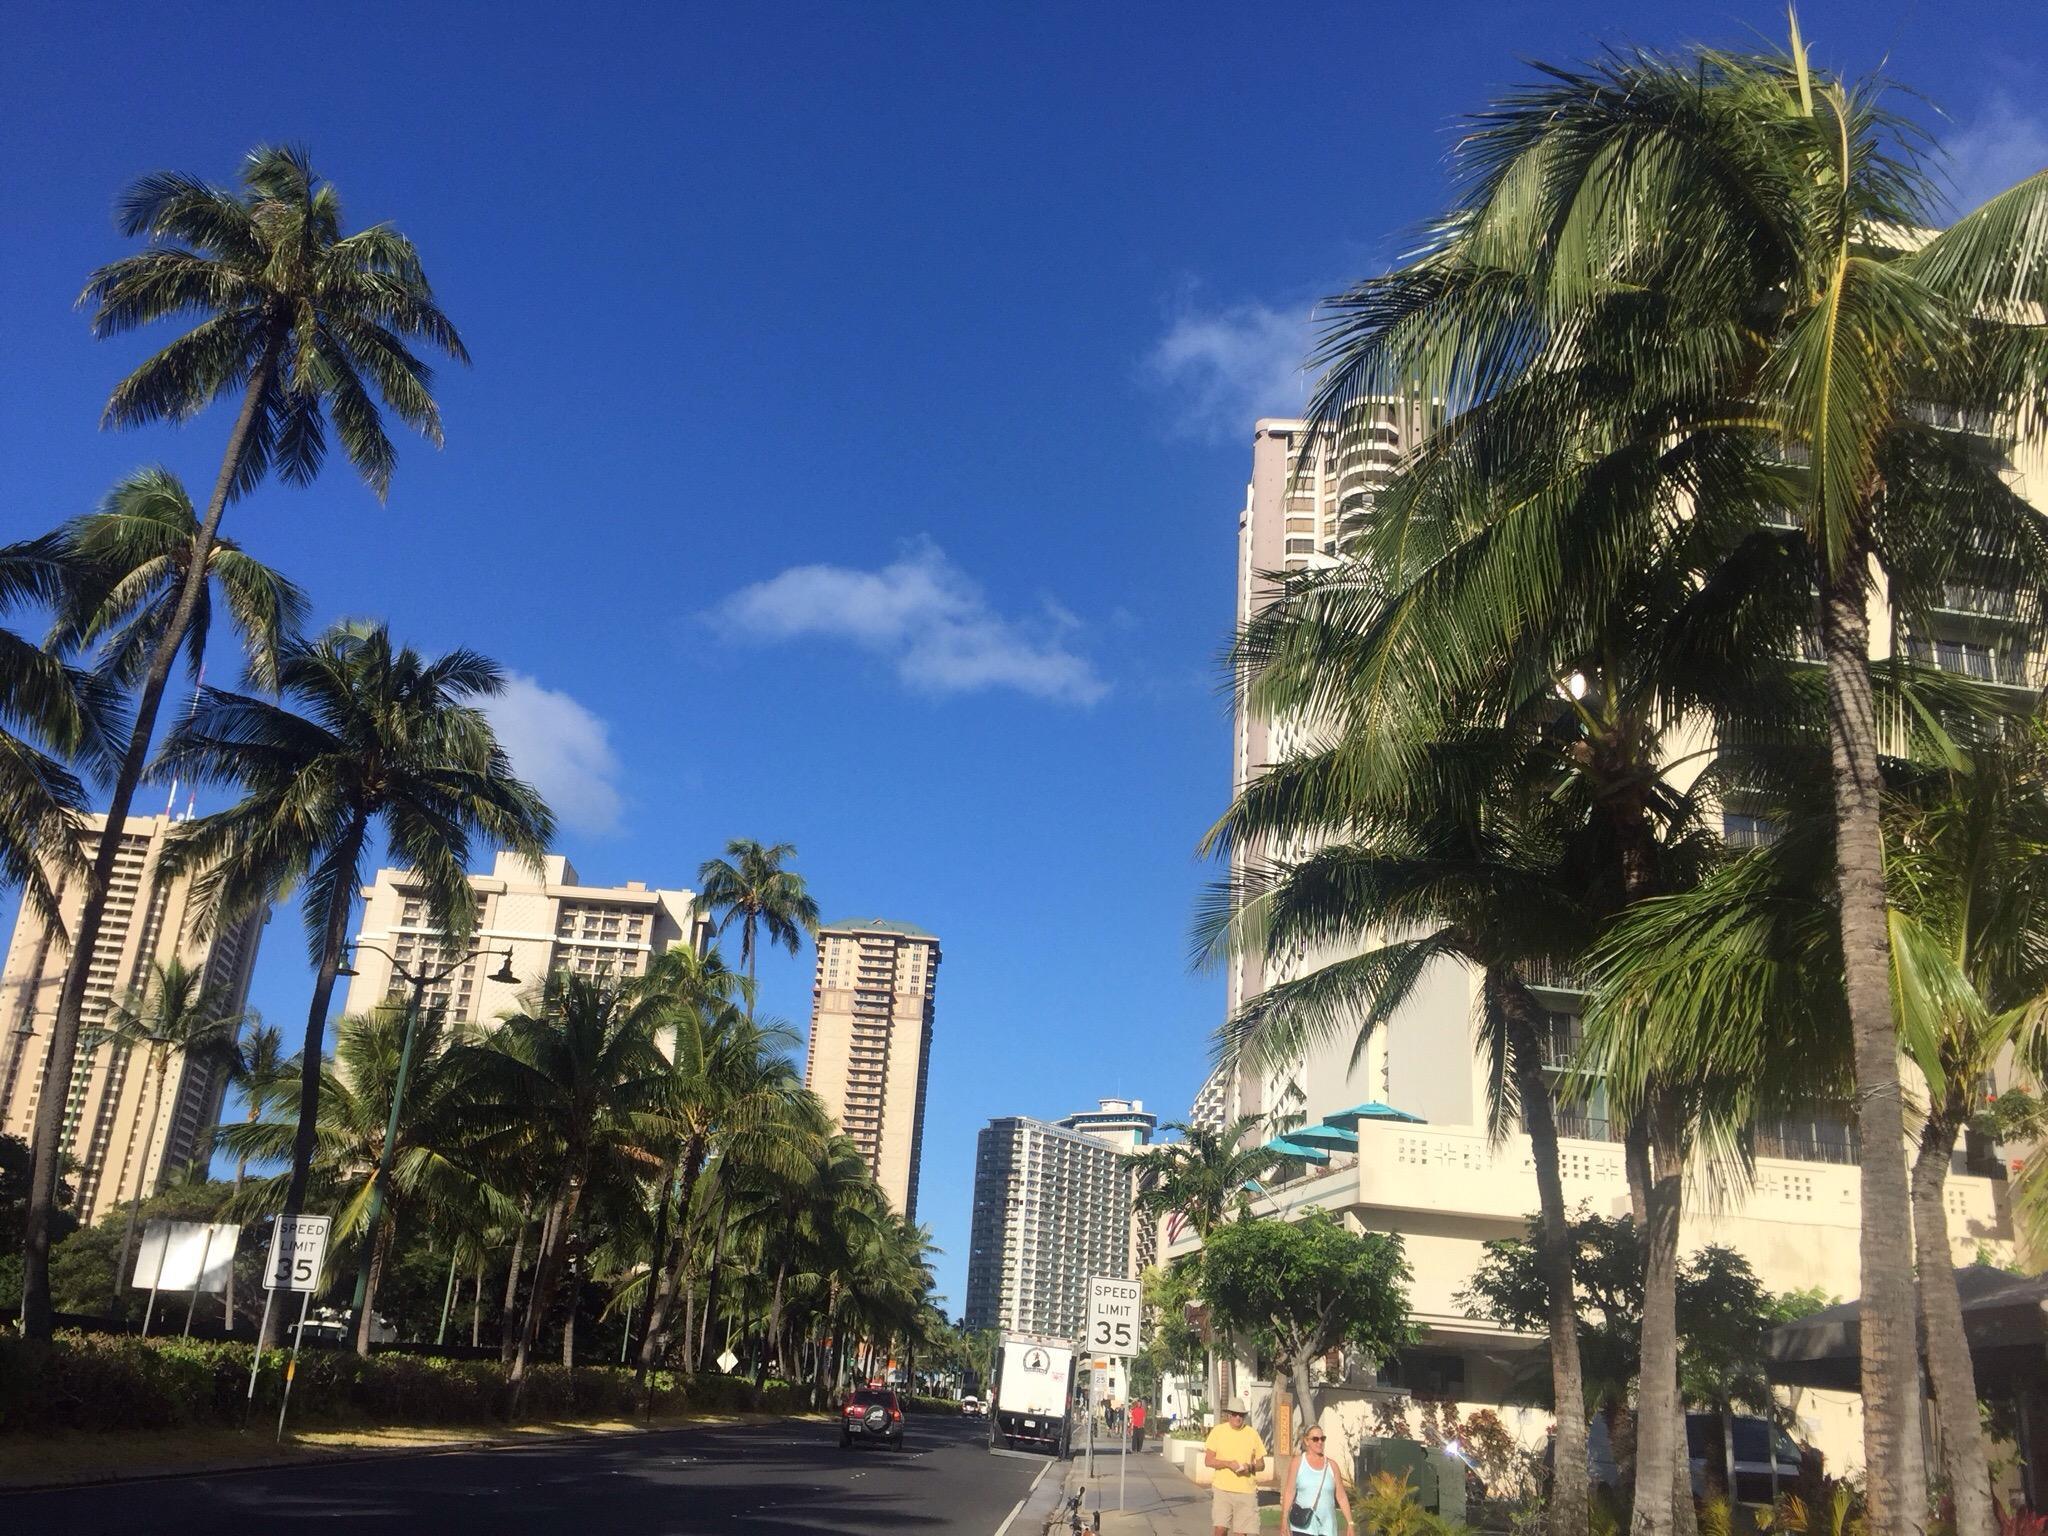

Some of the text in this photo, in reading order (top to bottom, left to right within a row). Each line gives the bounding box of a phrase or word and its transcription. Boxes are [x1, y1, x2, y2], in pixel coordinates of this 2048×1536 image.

[280, 1223, 324, 1235] SPEED
[280, 1240, 315, 1252] LIMIT
[274, 1257, 312, 1281] 35
[1094, 1285, 1136, 1299] SPEED
[1098, 1303, 1131, 1316] LIMIT
[1095, 1321, 1131, 1346] 35
